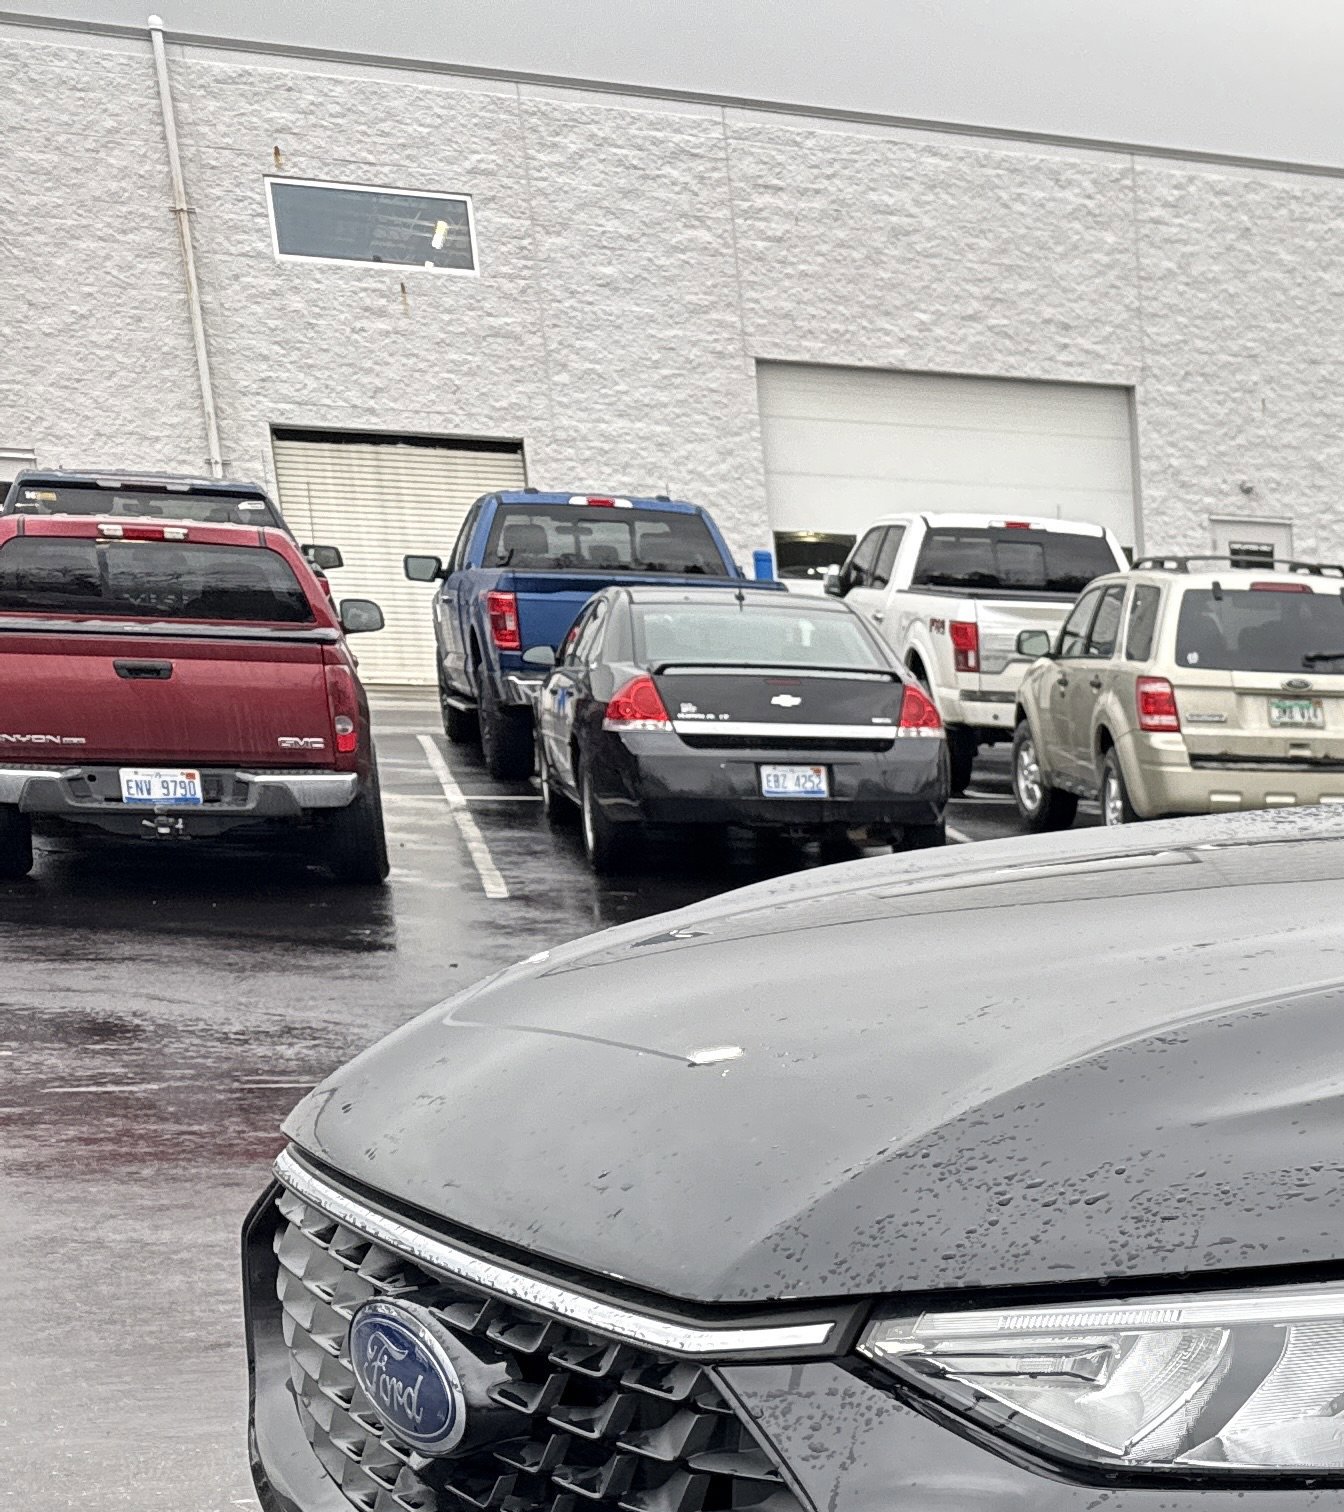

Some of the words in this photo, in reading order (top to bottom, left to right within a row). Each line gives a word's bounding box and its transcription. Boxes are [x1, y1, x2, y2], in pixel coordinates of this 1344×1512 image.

[277, 736, 325, 749] GMC
[126, 780, 152, 796] ENV
[161, 780, 196, 797] 9790
[363, 1331, 424, 1424] Ford
